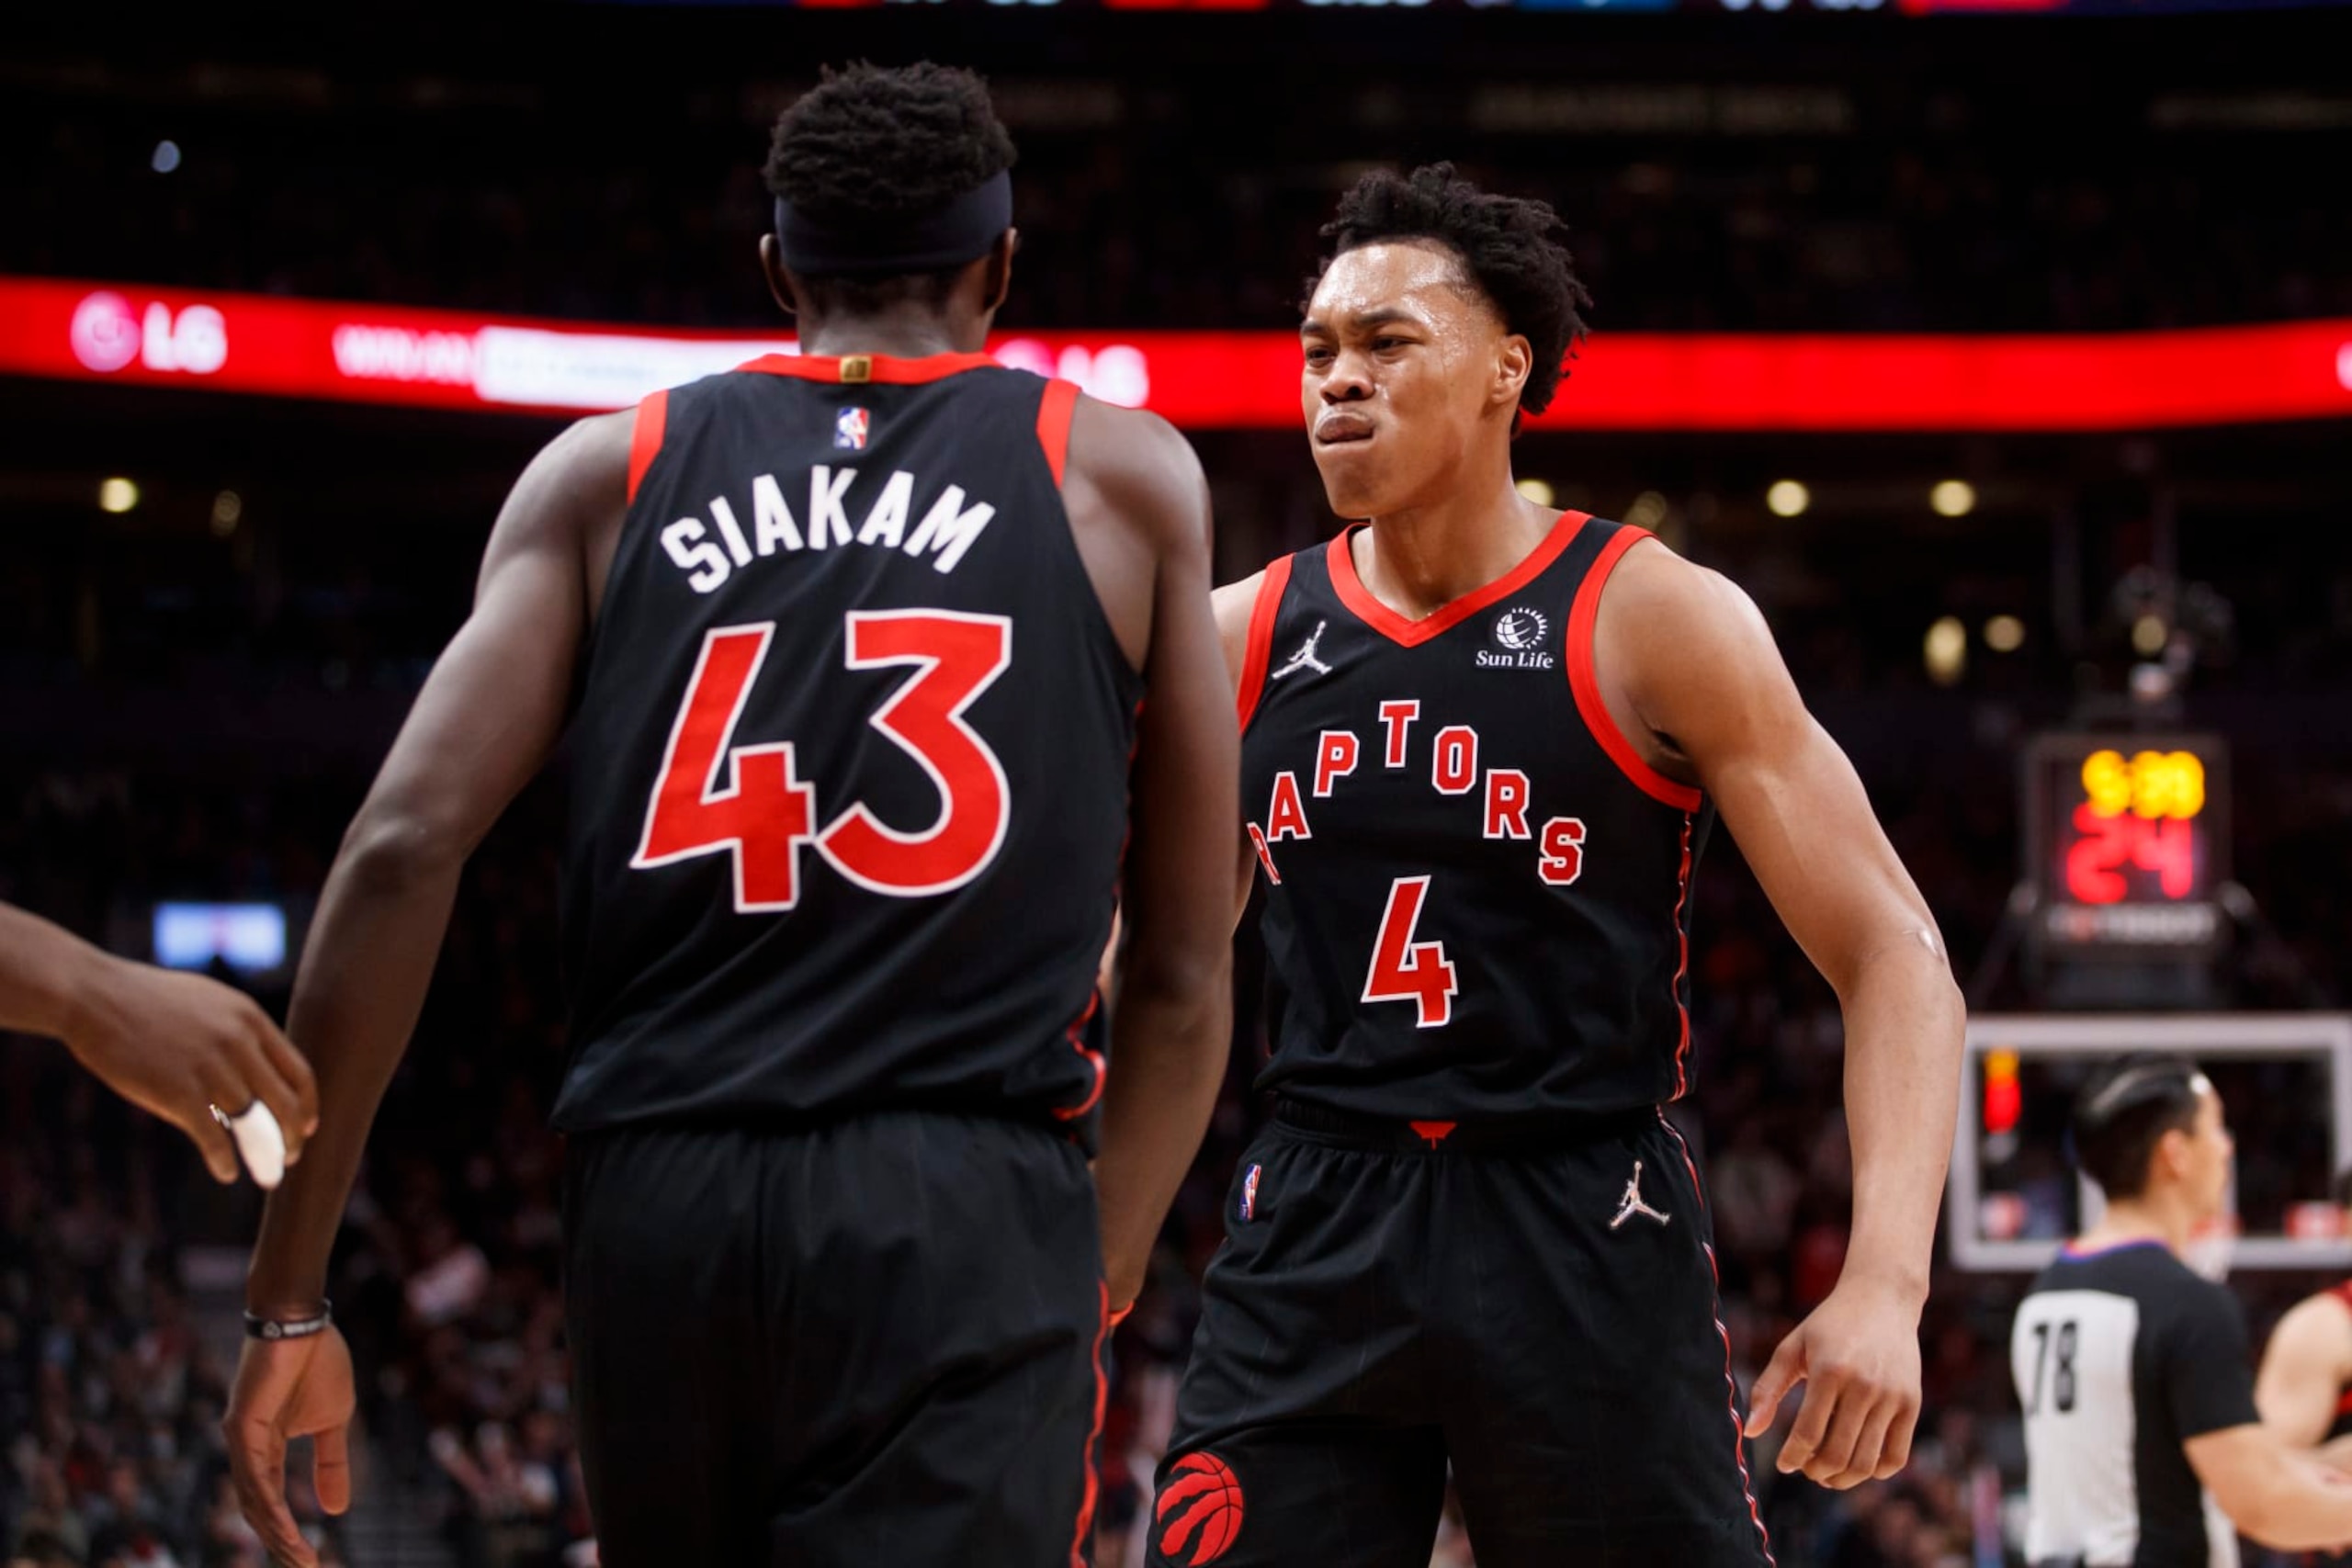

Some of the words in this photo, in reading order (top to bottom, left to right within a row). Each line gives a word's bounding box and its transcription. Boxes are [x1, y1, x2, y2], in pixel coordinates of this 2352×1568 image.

[141, 301, 227, 374] LG
[660, 465, 995, 593] SIAKAM
[1476, 649, 1513, 667] Sun
[1517, 651, 1554, 669] Life
[630, 607, 1012, 914] 43
[2066, 801, 2193, 904] 24
[1361, 874, 1457, 1028] 4
[2031, 1319, 2079, 1416] 78
